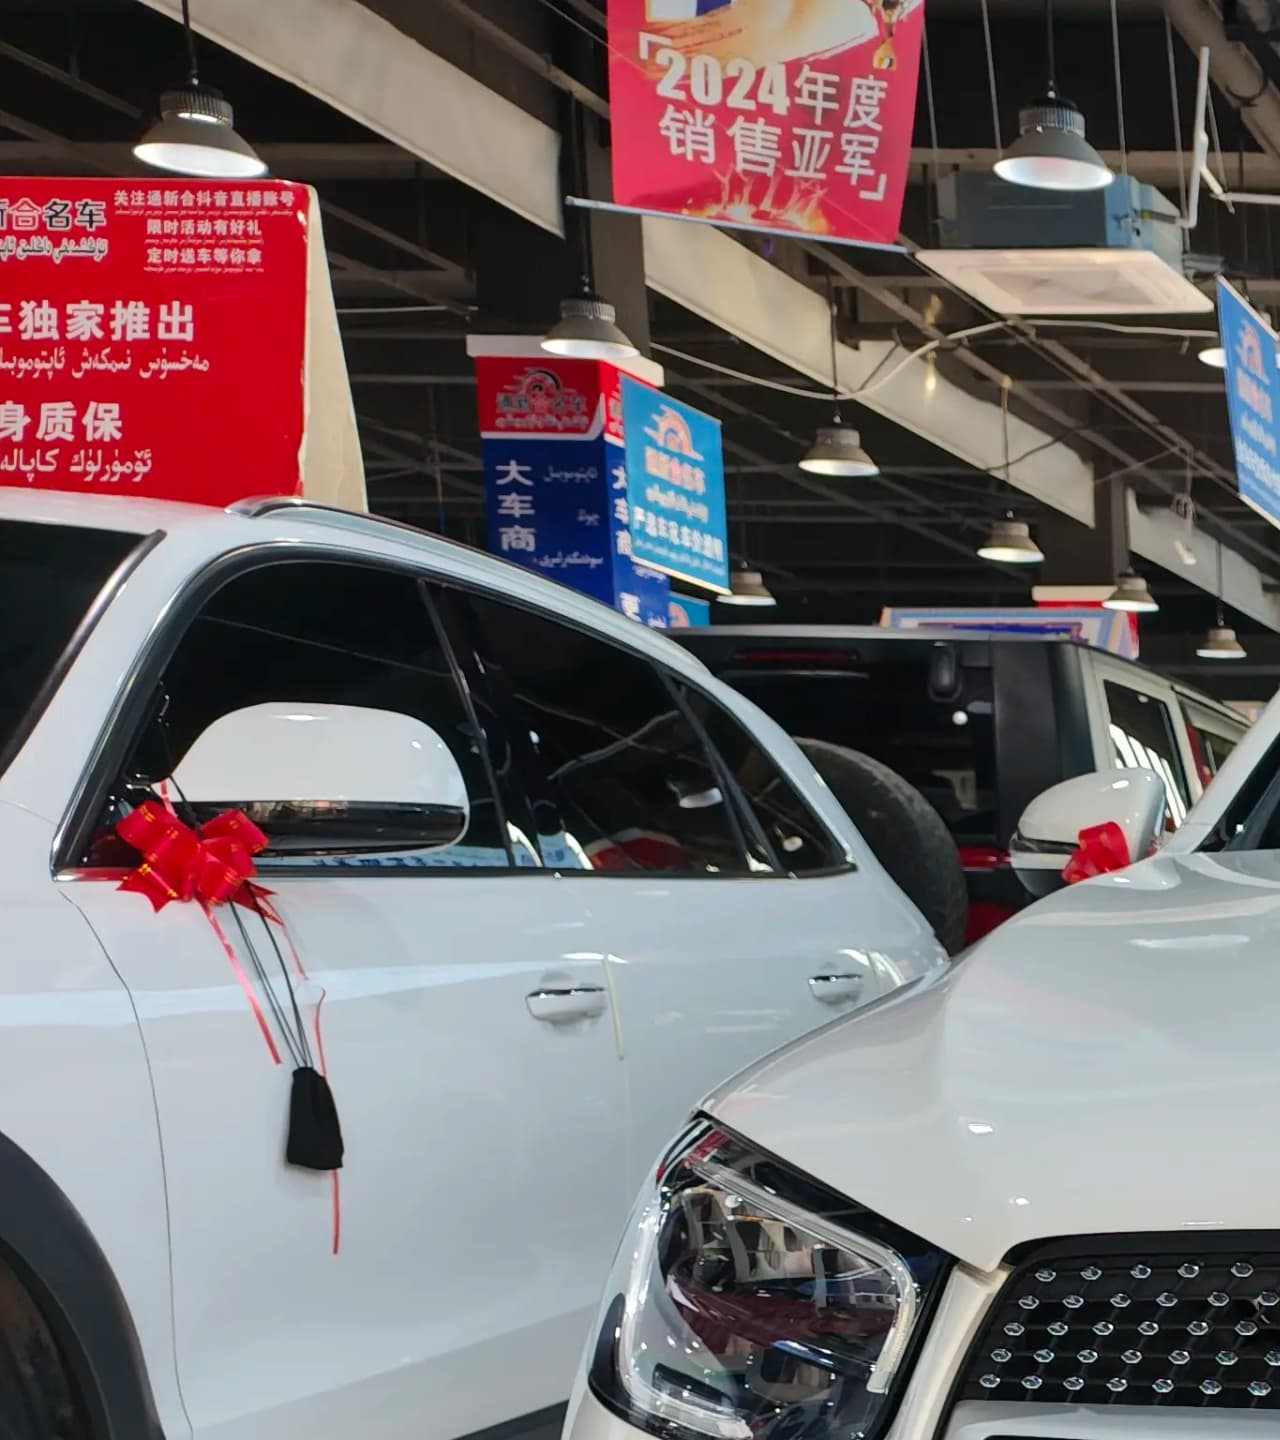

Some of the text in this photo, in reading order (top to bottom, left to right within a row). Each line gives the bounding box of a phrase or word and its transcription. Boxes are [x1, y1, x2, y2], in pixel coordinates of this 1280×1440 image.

[114, 189, 295, 208] 关注通新合抖音直播账号
[147, 219, 262, 236] 限时活动有好礼
[147, 248, 262, 265] 定时送车等你拿
[495, 458, 537, 552] 大车商
